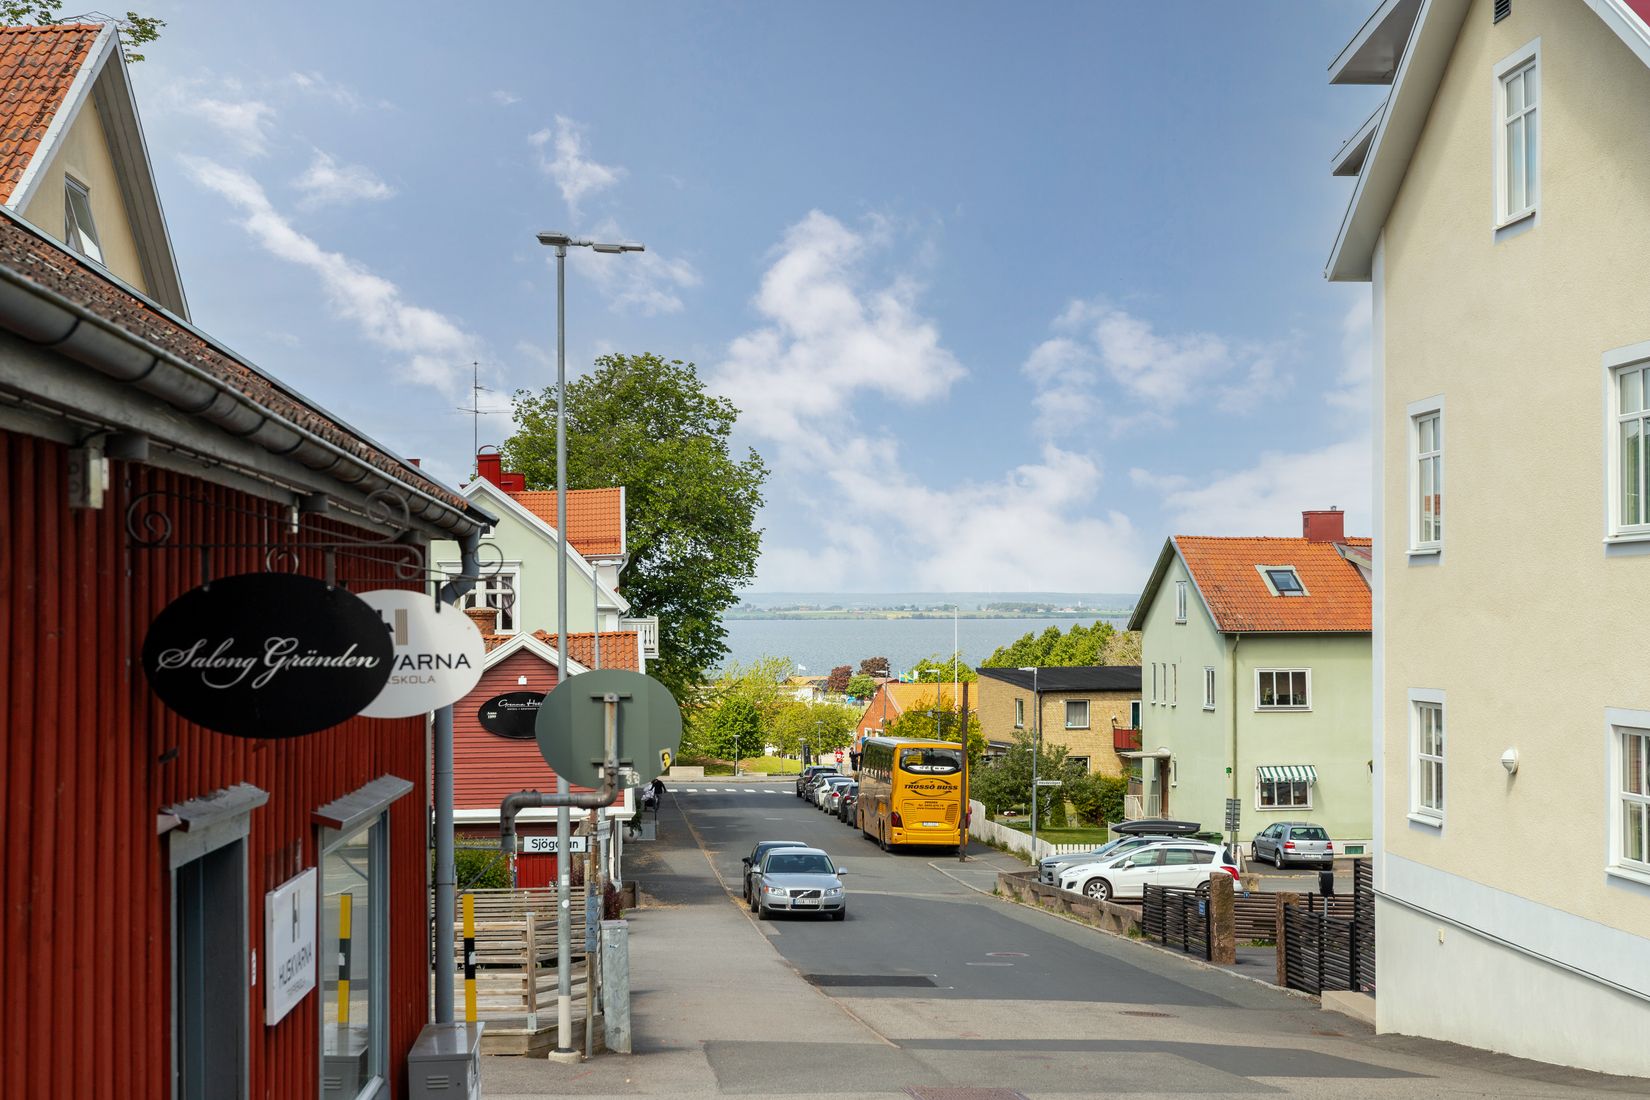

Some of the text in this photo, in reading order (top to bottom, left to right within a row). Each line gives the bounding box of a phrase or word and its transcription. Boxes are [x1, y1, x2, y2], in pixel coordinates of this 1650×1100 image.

[156, 636, 380, 689] Salong Gränden
[387, 675, 436, 685] SKOLA
